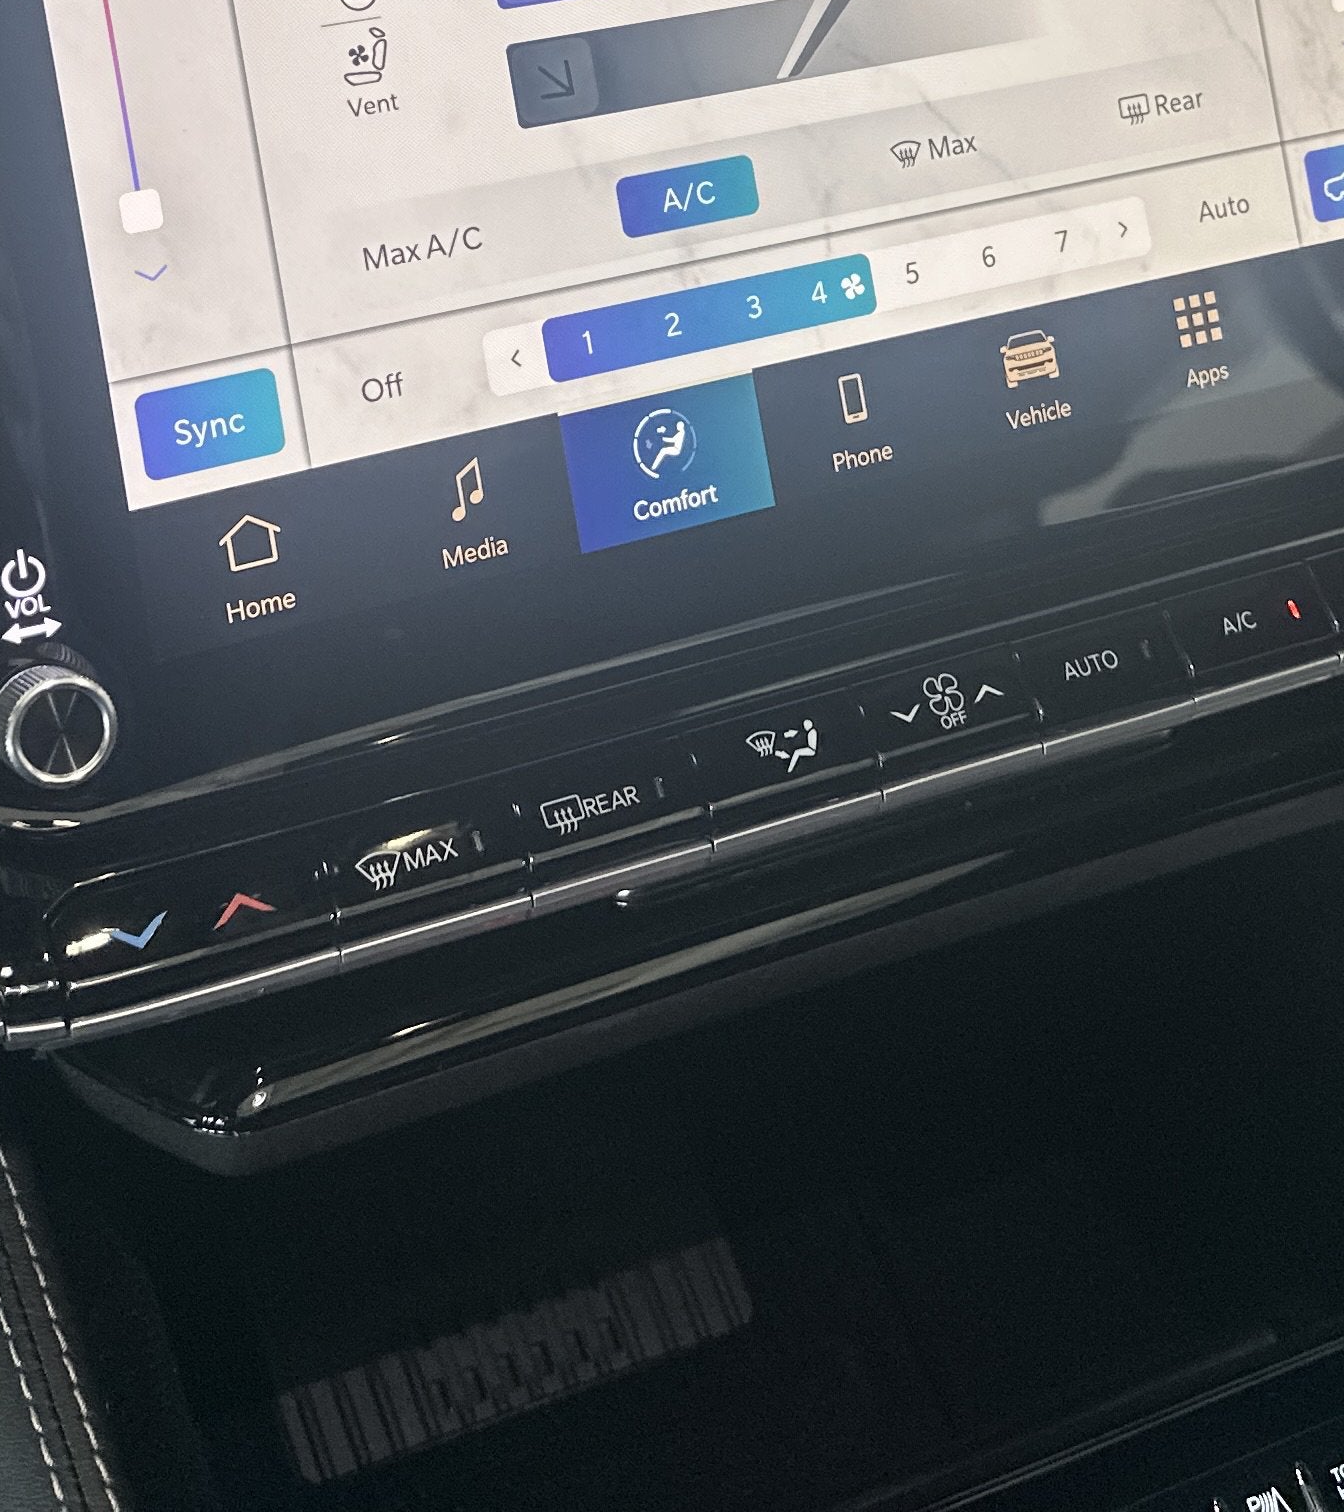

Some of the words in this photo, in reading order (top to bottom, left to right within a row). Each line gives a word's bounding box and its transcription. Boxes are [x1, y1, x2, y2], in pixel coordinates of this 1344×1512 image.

[347, 94, 399, 117] Vent
[1155, 90, 1204, 118] Rear
[929, 133, 978, 161] Max
[663, 181, 716, 213] A/C
[1199, 195, 1250, 223] Auto
[363, 242, 421, 272] Max
[426, 226, 483, 259] A/C
[581, 330, 595, 354] 1
[665, 312, 682, 337] 2
[746, 295, 763, 320] 3
[811, 282, 827, 305] 4
[905, 263, 920, 286] 5
[981, 246, 996, 269] 6
[1053, 230, 1069, 253] 7
[360, 372, 404, 403] Off
[1186, 363, 1230, 389] Apps
[174, 411, 246, 448] Sync
[1005, 399, 1072, 431] Vehicle
[832, 443, 893, 472] Phone
[633, 484, 718, 522] Comfort
[442, 535, 509, 569] Media
[4, 594, 52, 619] VOL
[226, 591, 297, 623] Home
[1223, 610, 1257, 637] A/C
[1064, 649, 1119, 680] AUTO
[941, 708, 968, 729] OFF
[582, 786, 641, 818] REAR
[403, 838, 459, 873] MAX
